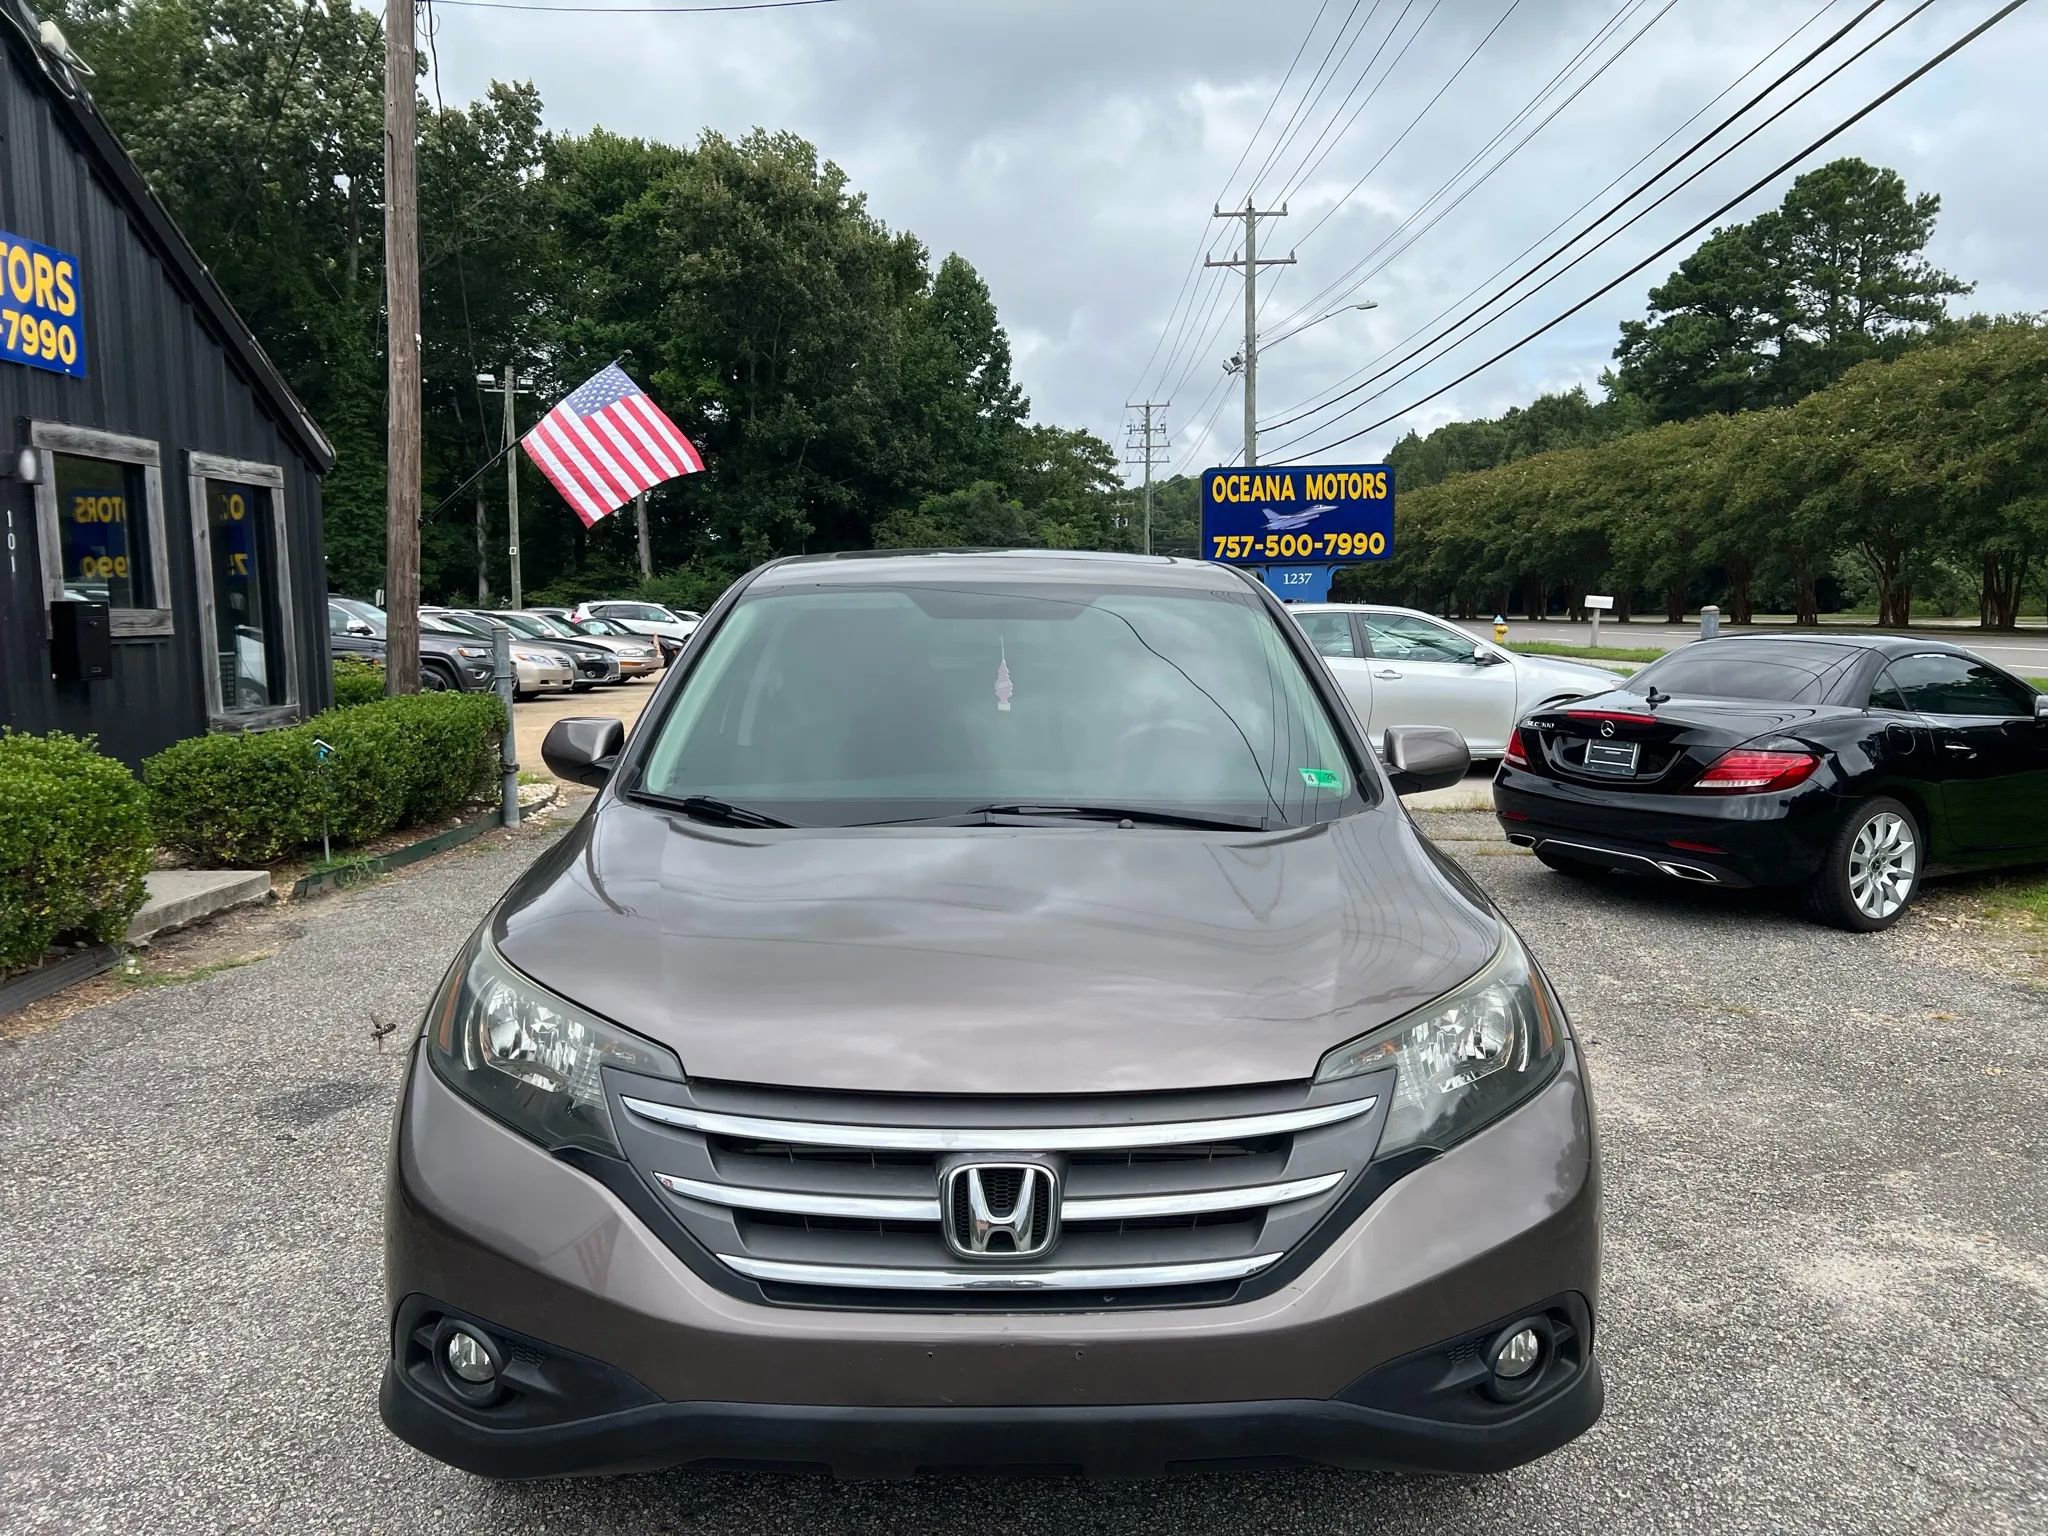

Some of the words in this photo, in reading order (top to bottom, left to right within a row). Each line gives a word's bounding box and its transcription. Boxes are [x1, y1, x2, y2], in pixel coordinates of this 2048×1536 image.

[0, 309, 76, 365] 7990
[1212, 474, 1295, 503] OCEANA
[1306, 472, 1387, 500] MOTORS
[7, 510, 15, 573] 101
[1213, 532, 1385, 558] 757-500-7990
[1283, 572, 1313, 585] 1237
